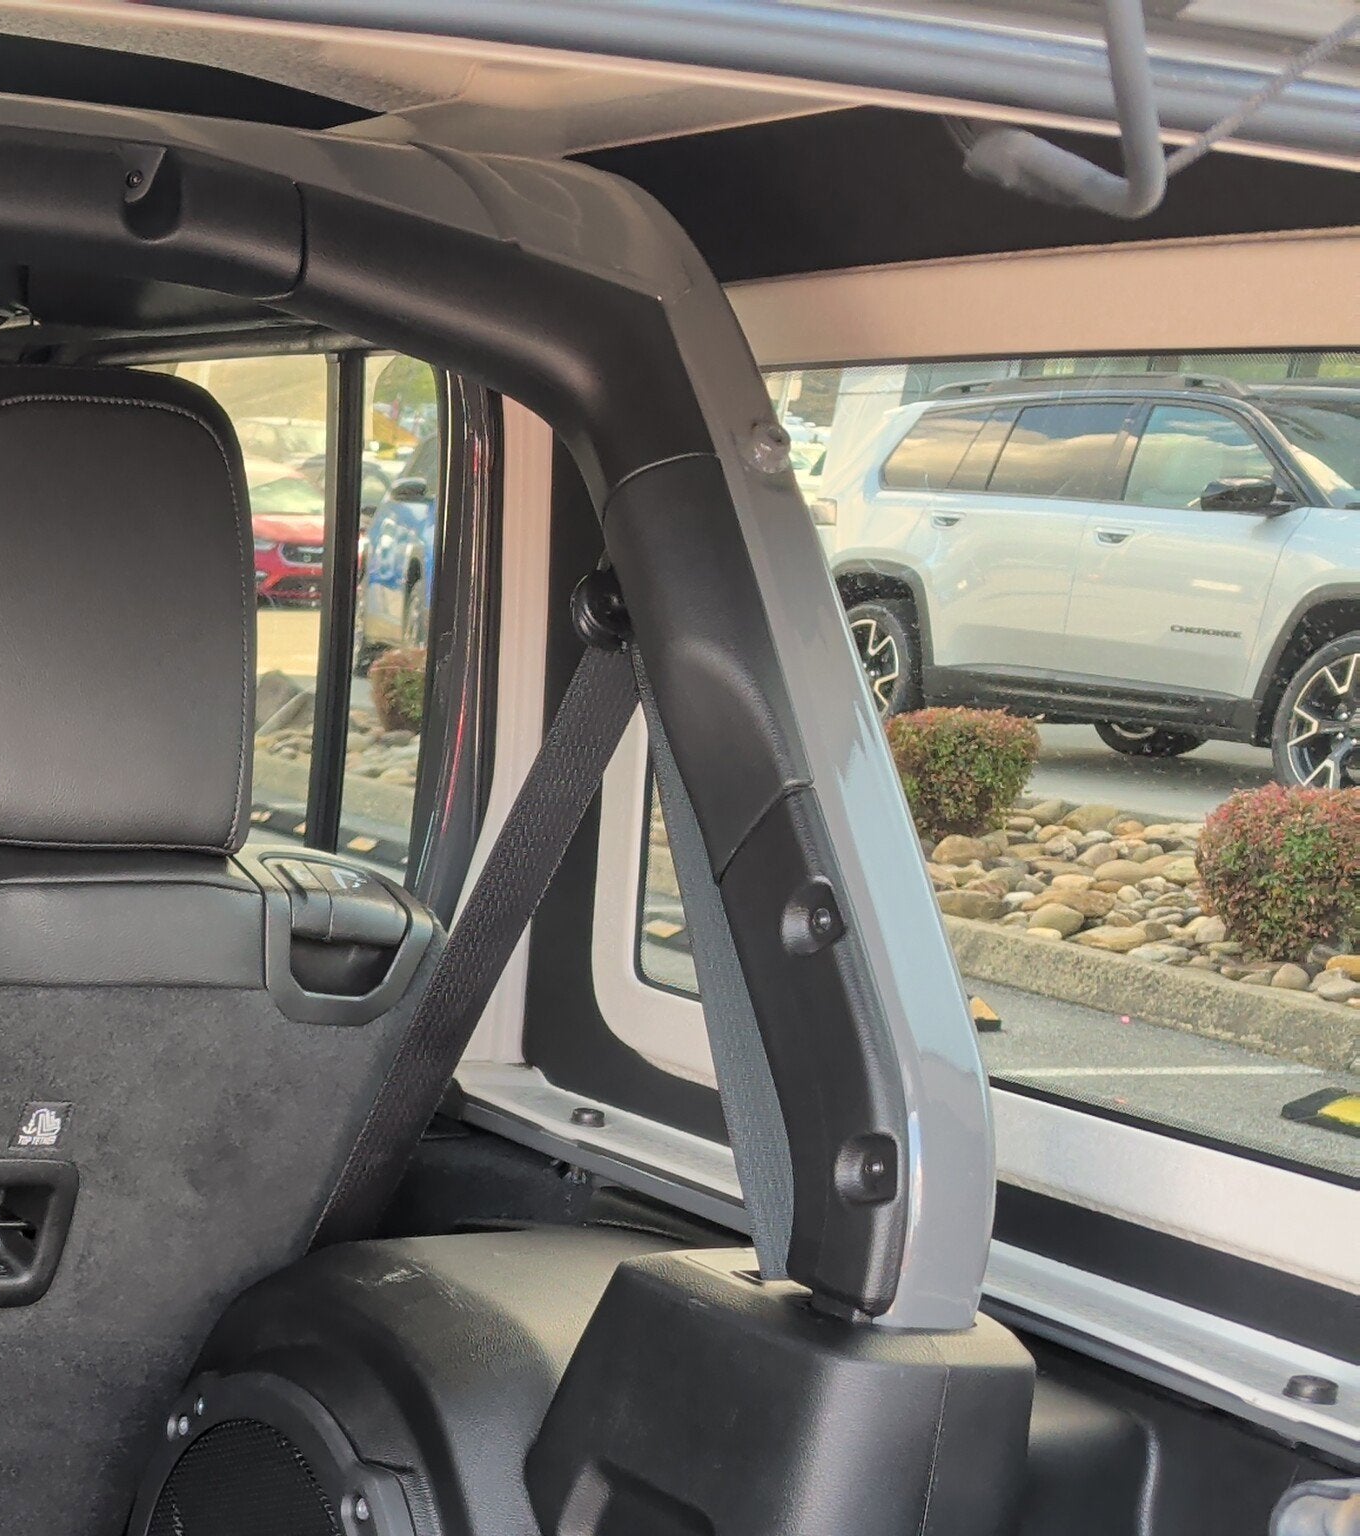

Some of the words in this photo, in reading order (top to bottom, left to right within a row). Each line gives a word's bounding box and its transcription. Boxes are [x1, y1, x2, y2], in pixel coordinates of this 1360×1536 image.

[1170, 624, 1242, 639] CHEROKEE
[17, 1134, 33, 1146] TOP
[31, 1135, 58, 1146] TETHER
